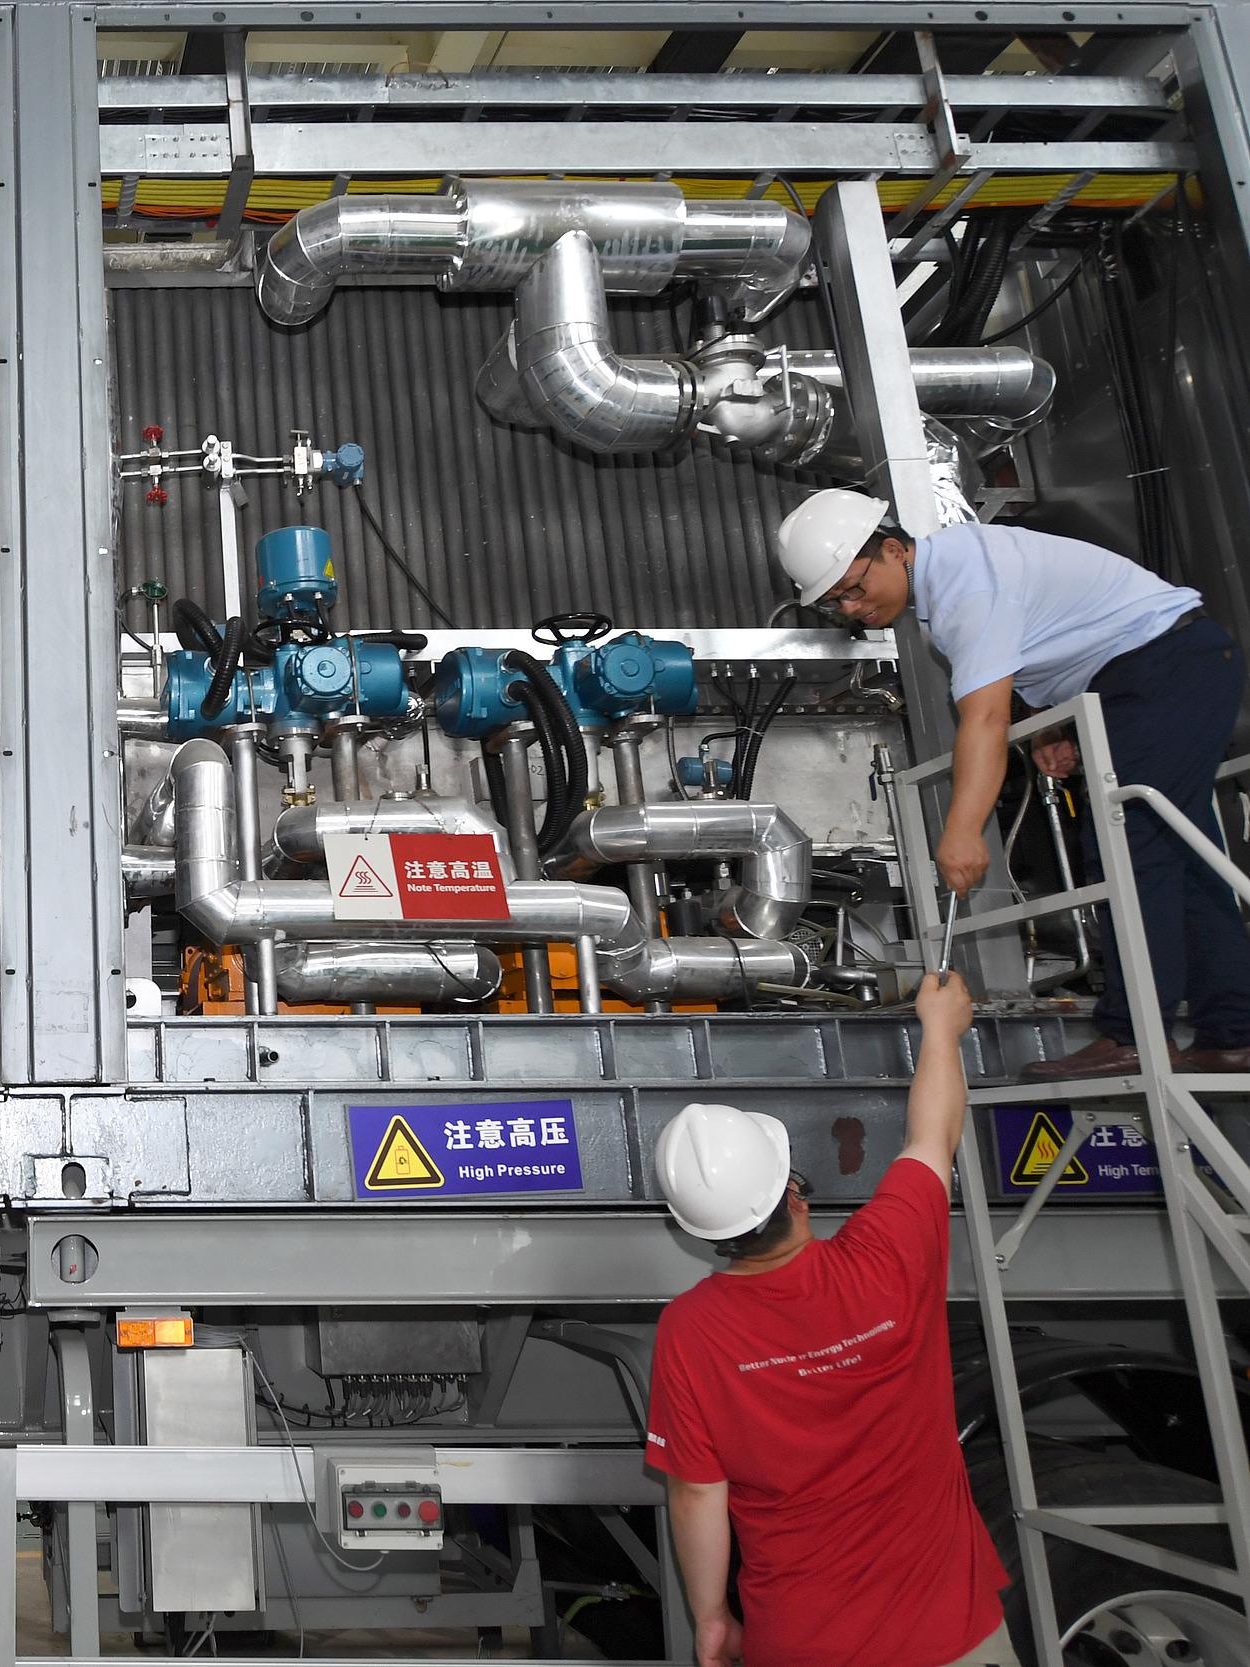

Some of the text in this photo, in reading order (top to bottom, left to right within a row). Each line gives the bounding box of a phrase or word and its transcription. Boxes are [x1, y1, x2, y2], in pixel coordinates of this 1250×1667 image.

[404, 860, 494, 879] 注意高温
[407, 883, 496, 894] Note Temperature
[444, 1117, 570, 1150] 注意高压
[458, 1163, 566, 1180] High Pressure
[1098, 1164, 1129, 1179] High
[739, 1361, 770, 1371] Better
[807, 1343, 843, 1359] Energy
